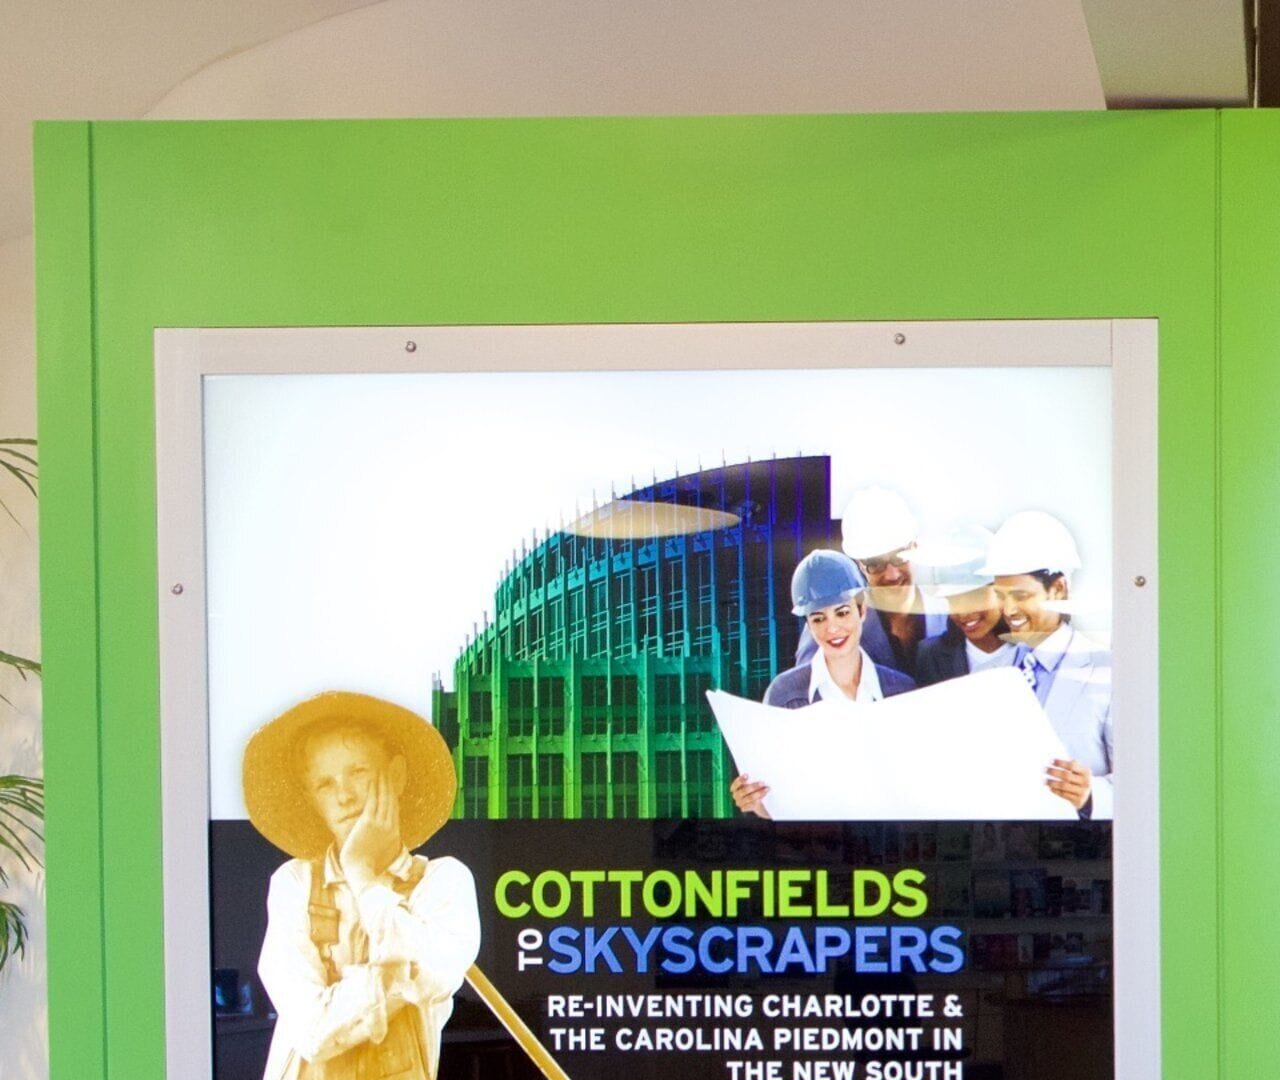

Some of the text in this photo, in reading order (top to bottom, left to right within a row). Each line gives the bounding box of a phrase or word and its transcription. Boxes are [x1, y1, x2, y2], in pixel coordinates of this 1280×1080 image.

[495, 869, 927, 918] COTTONFIELDS
[518, 928, 543, 971] TO
[548, 926, 963, 973] SKYSCRAPERS
[548, 995, 962, 1017] RE-INVENTING CHARLOTTE &
[550, 1028, 962, 1050] THE CAROLINA PIEDMONT IN
